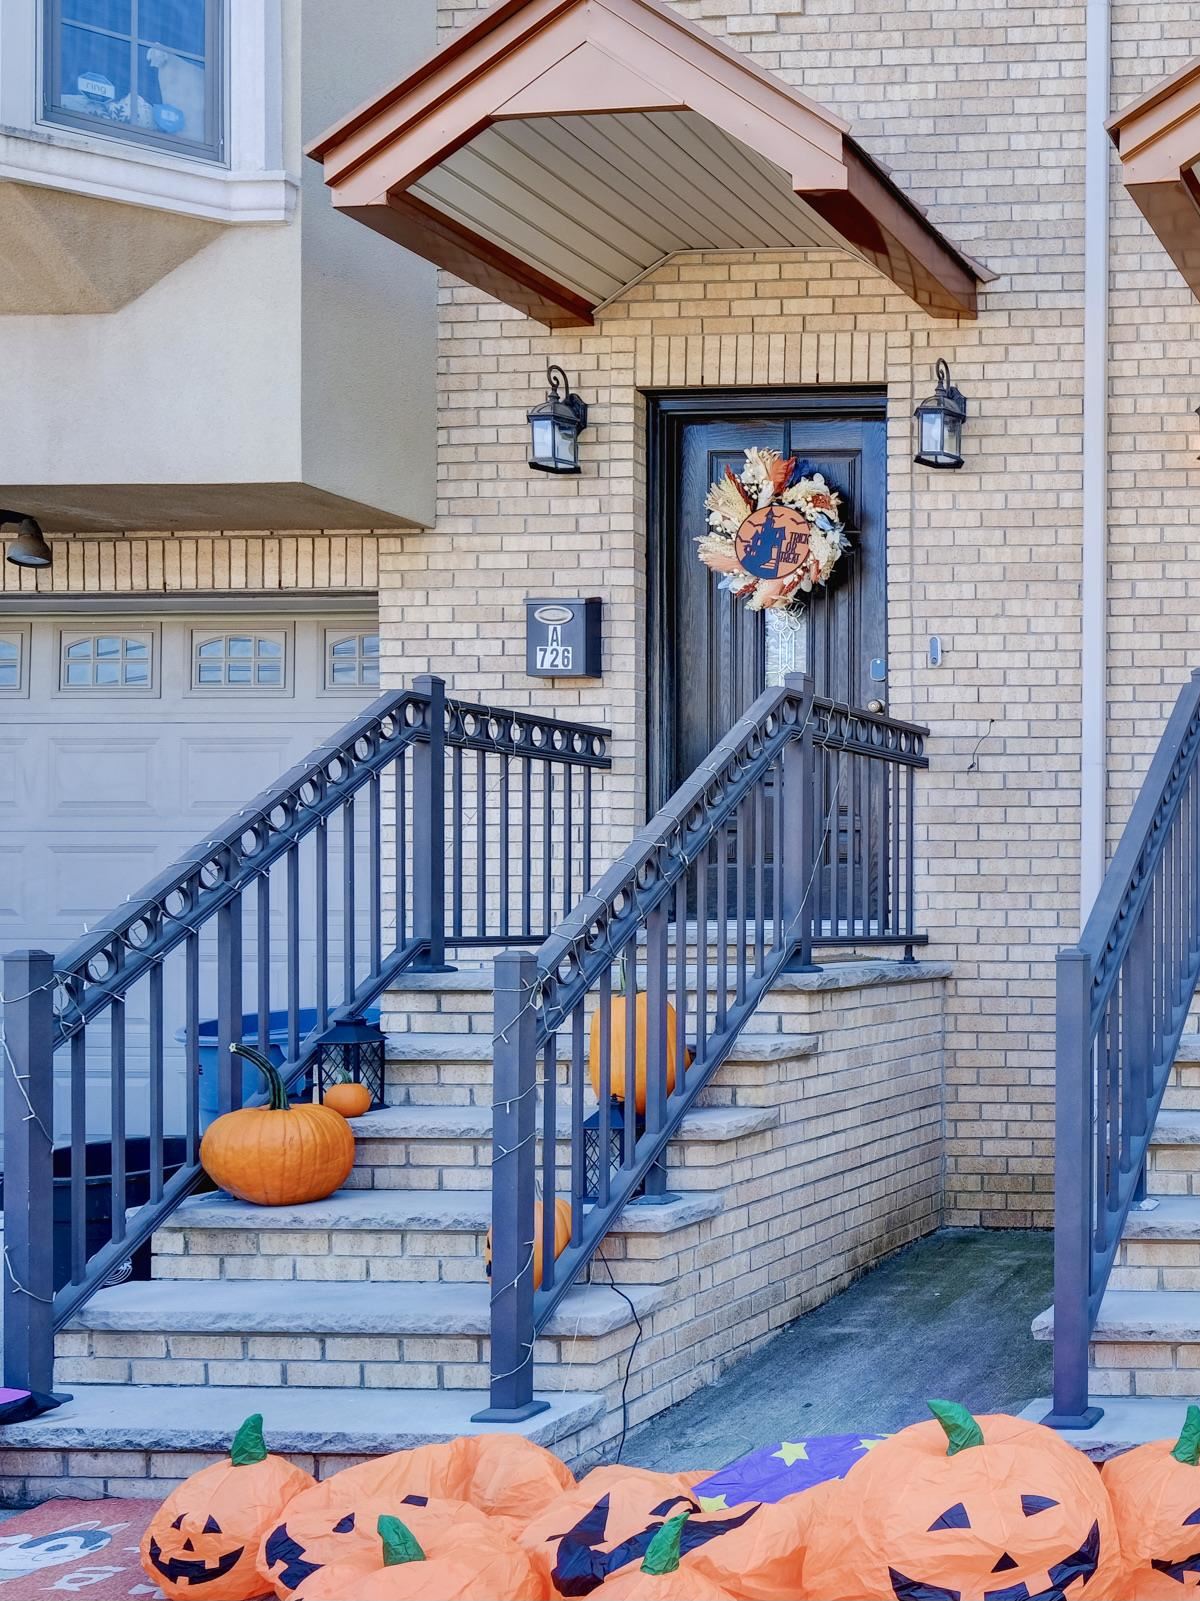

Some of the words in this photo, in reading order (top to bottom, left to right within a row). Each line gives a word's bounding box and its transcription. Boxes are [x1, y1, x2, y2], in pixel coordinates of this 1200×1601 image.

[85, 81, 107, 94] ring
[790, 532, 809, 544] TRICK
[786, 542, 797, 553] OR
[779, 552, 800, 564] TREAT
[550, 626, 560, 647] A
[538, 648, 571, 668] 726
